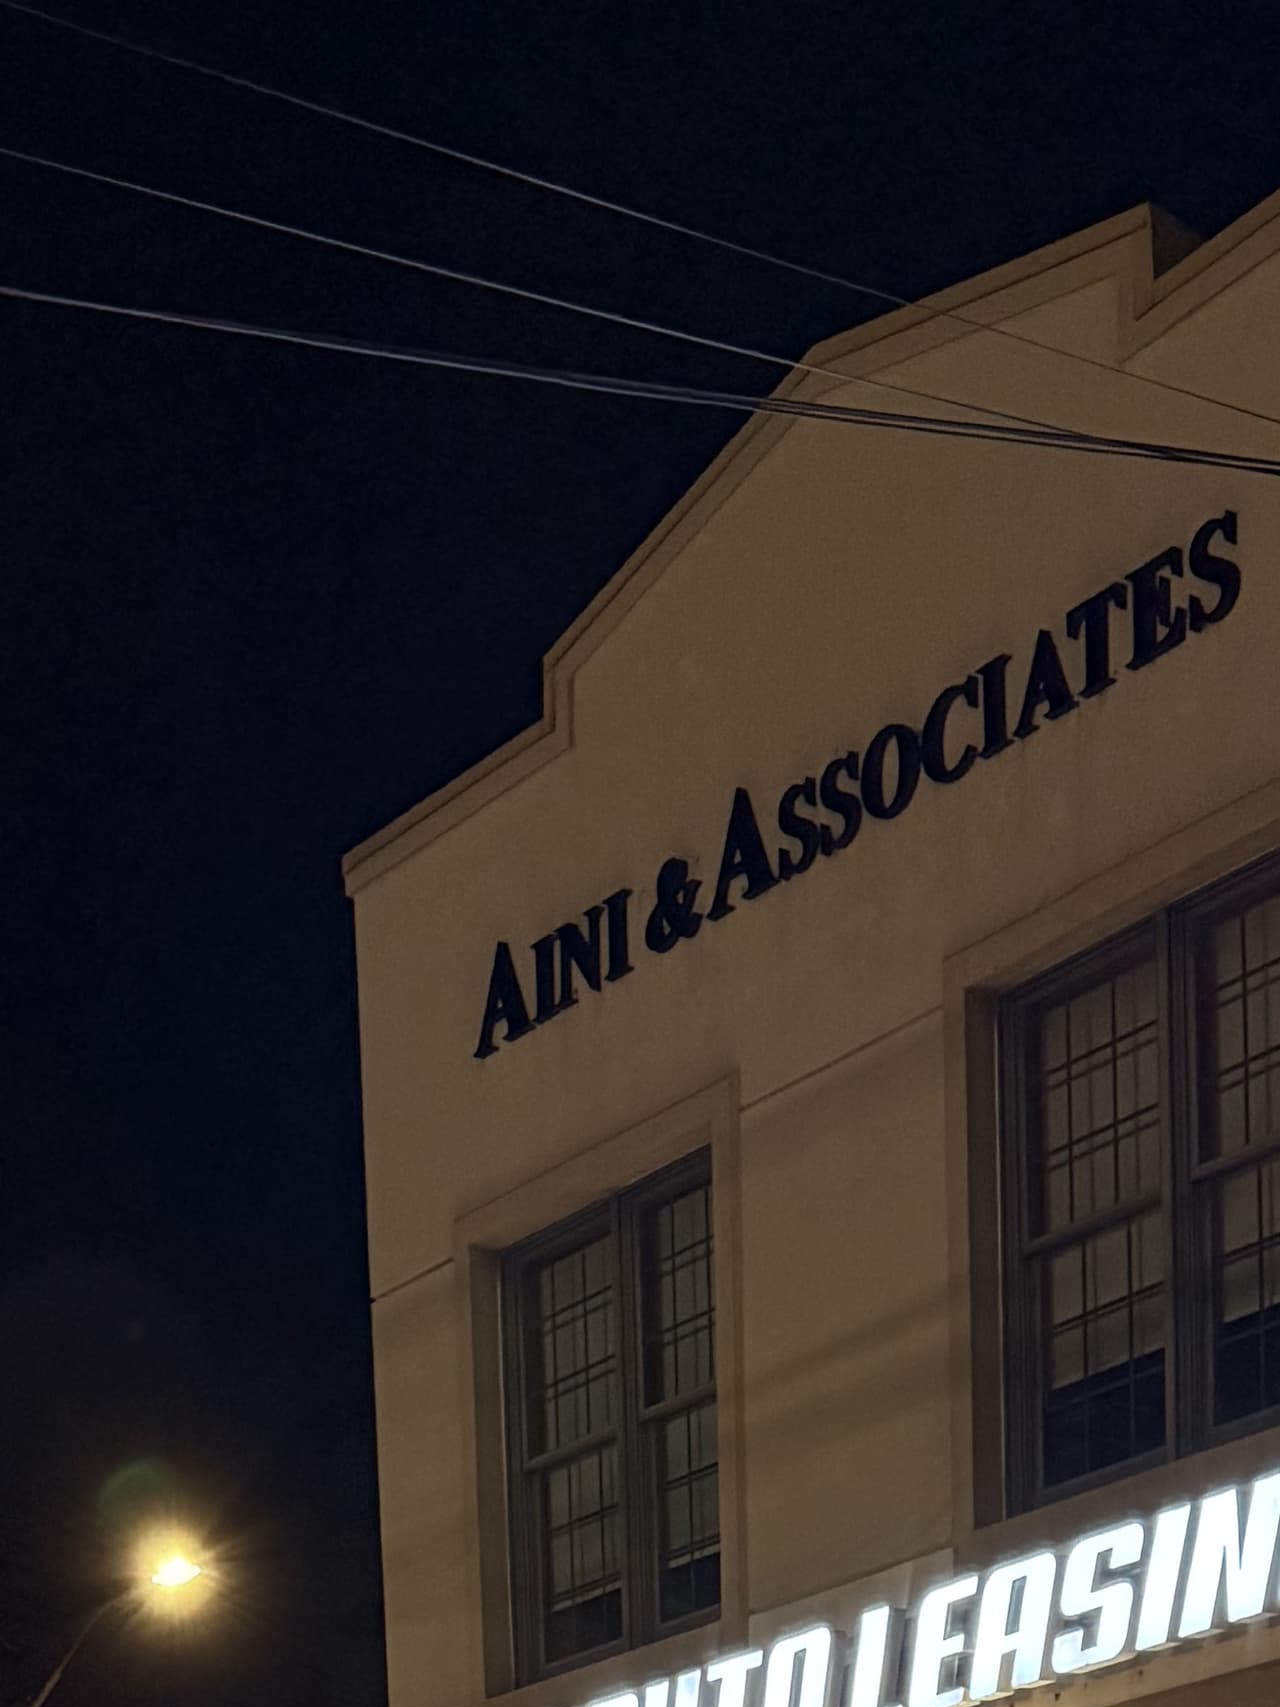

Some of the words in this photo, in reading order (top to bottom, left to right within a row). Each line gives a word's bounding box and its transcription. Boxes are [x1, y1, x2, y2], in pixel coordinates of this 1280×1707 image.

[473, 887, 634, 1060] AINI
[644, 857, 704, 954] &
[706, 509, 1242, 923] ASSOCIATES
